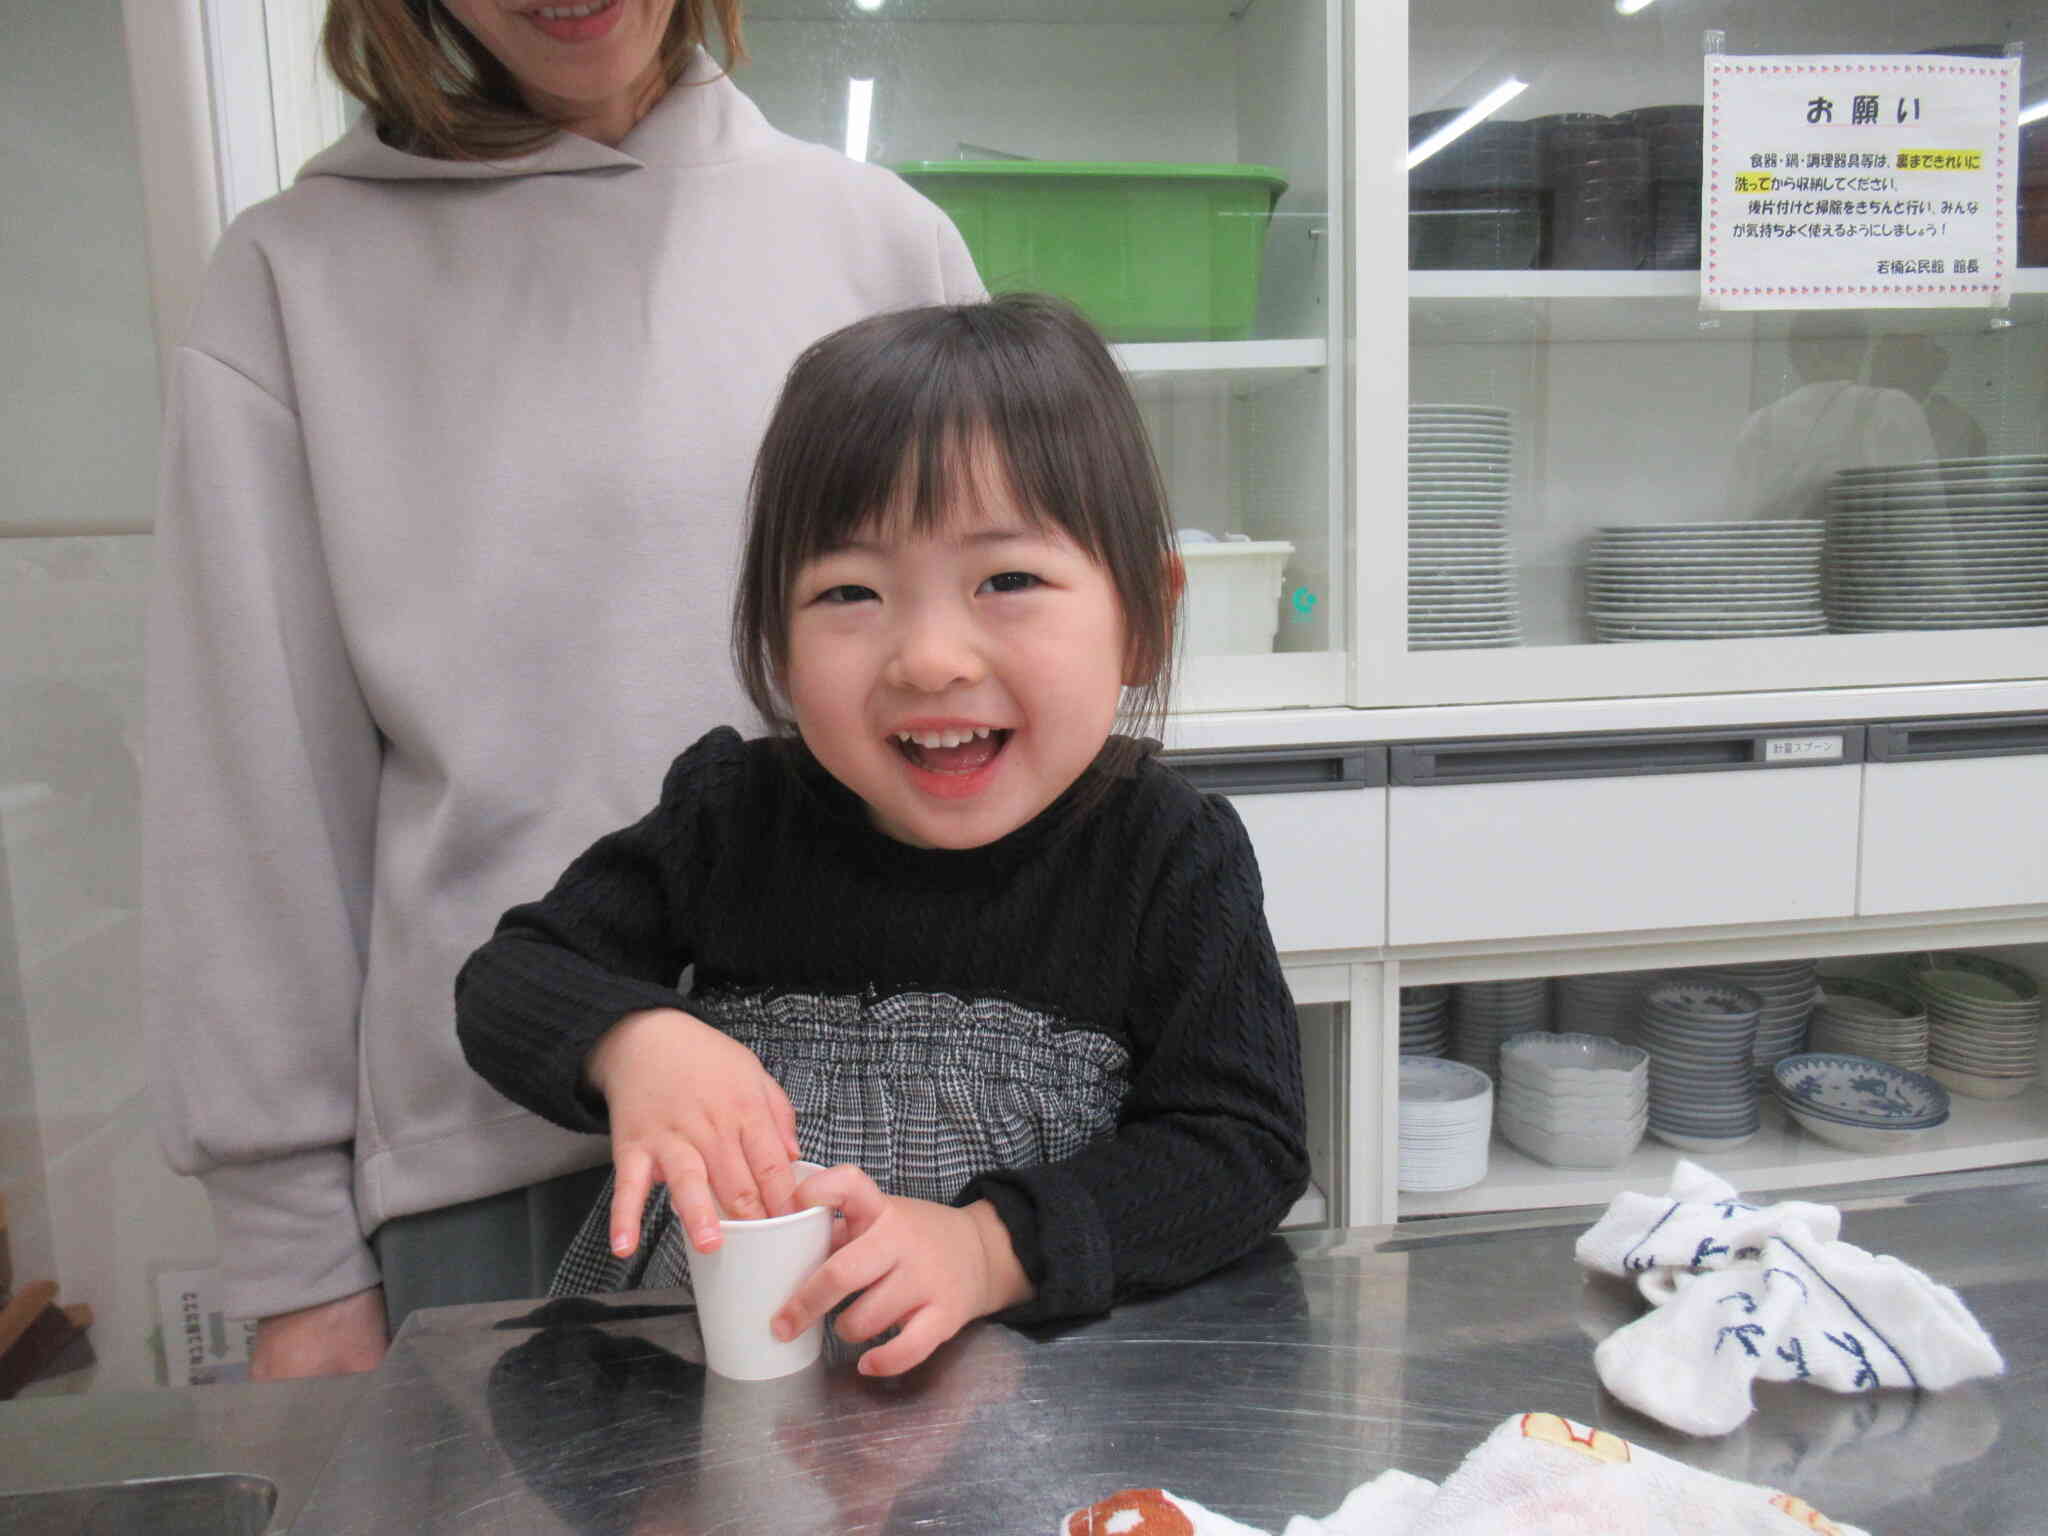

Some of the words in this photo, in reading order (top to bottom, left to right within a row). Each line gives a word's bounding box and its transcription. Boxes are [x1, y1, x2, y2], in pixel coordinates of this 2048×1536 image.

[1807, 96, 1919, 124] お願い
[1953, 259, 1979, 274] 館長
